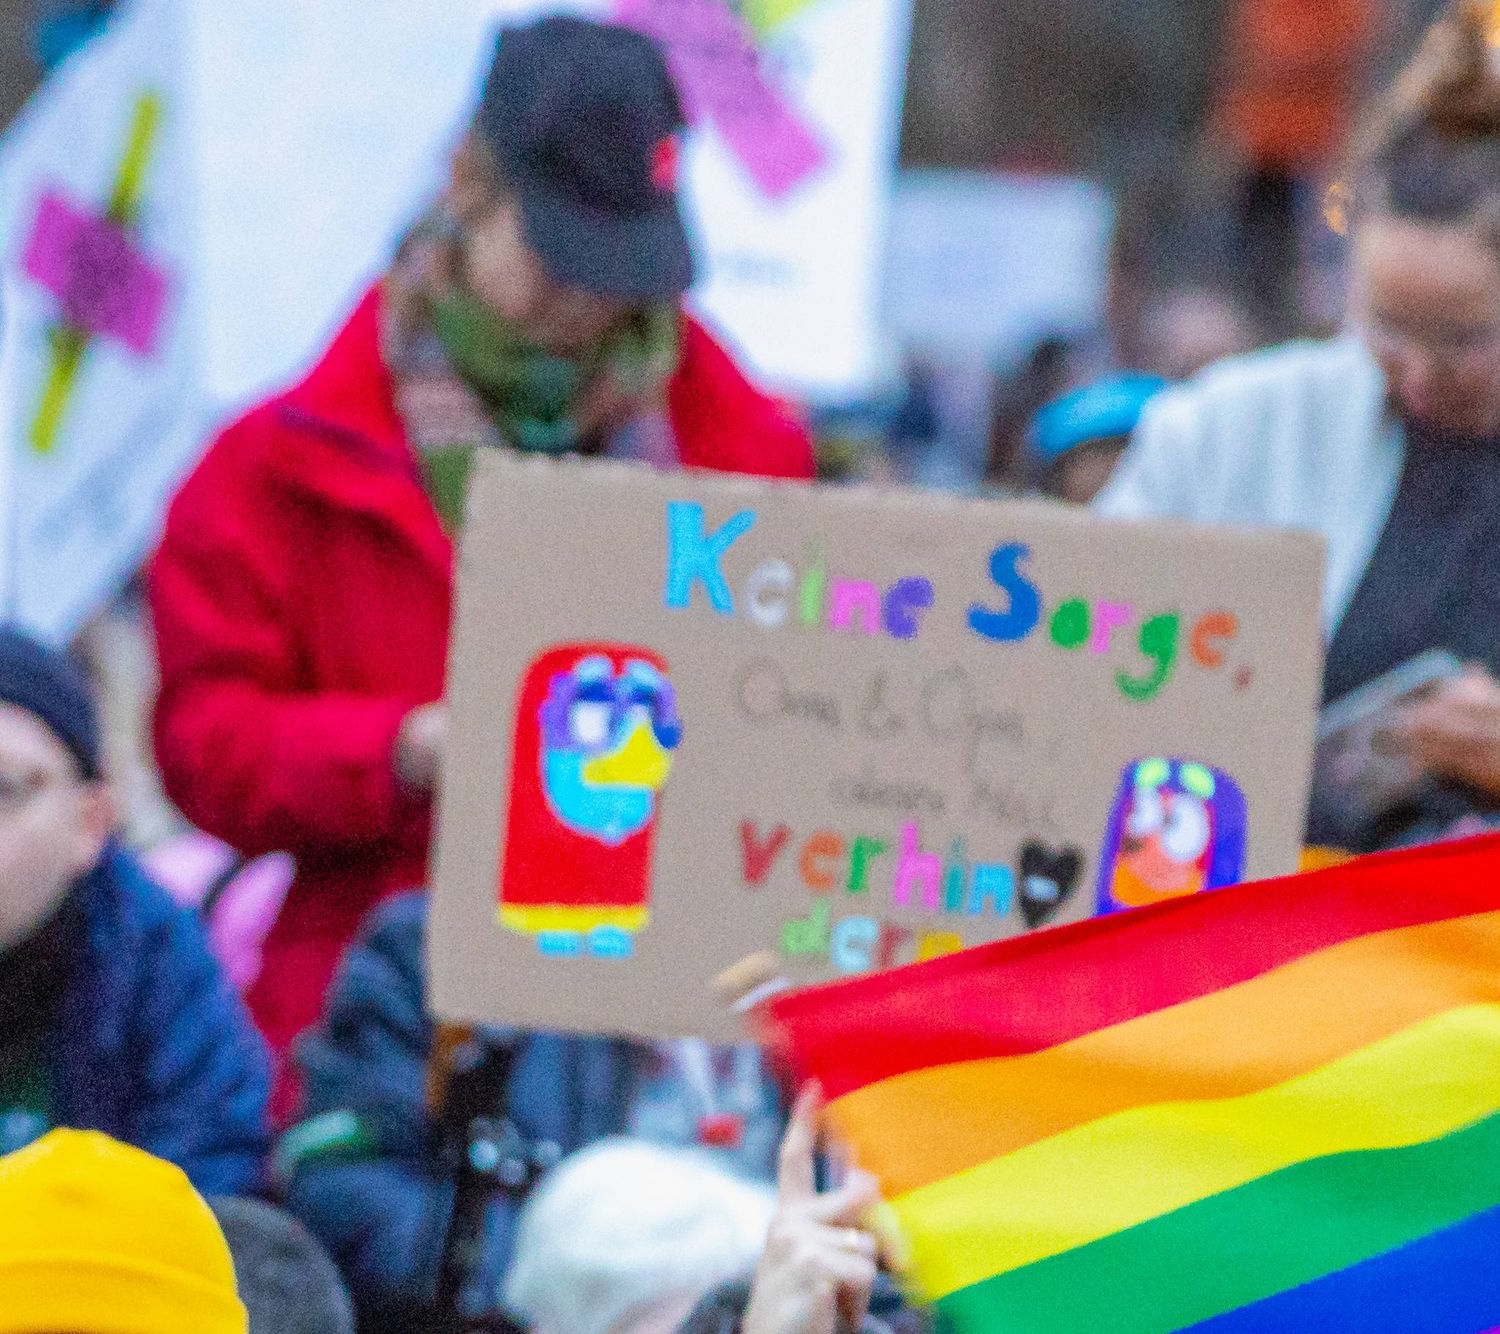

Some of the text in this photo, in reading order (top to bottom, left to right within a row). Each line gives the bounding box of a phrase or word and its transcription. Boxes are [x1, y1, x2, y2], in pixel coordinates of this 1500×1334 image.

[662, 500, 1253, 700] Keine Sorge,
[740, 819, 1015, 917] verhin
